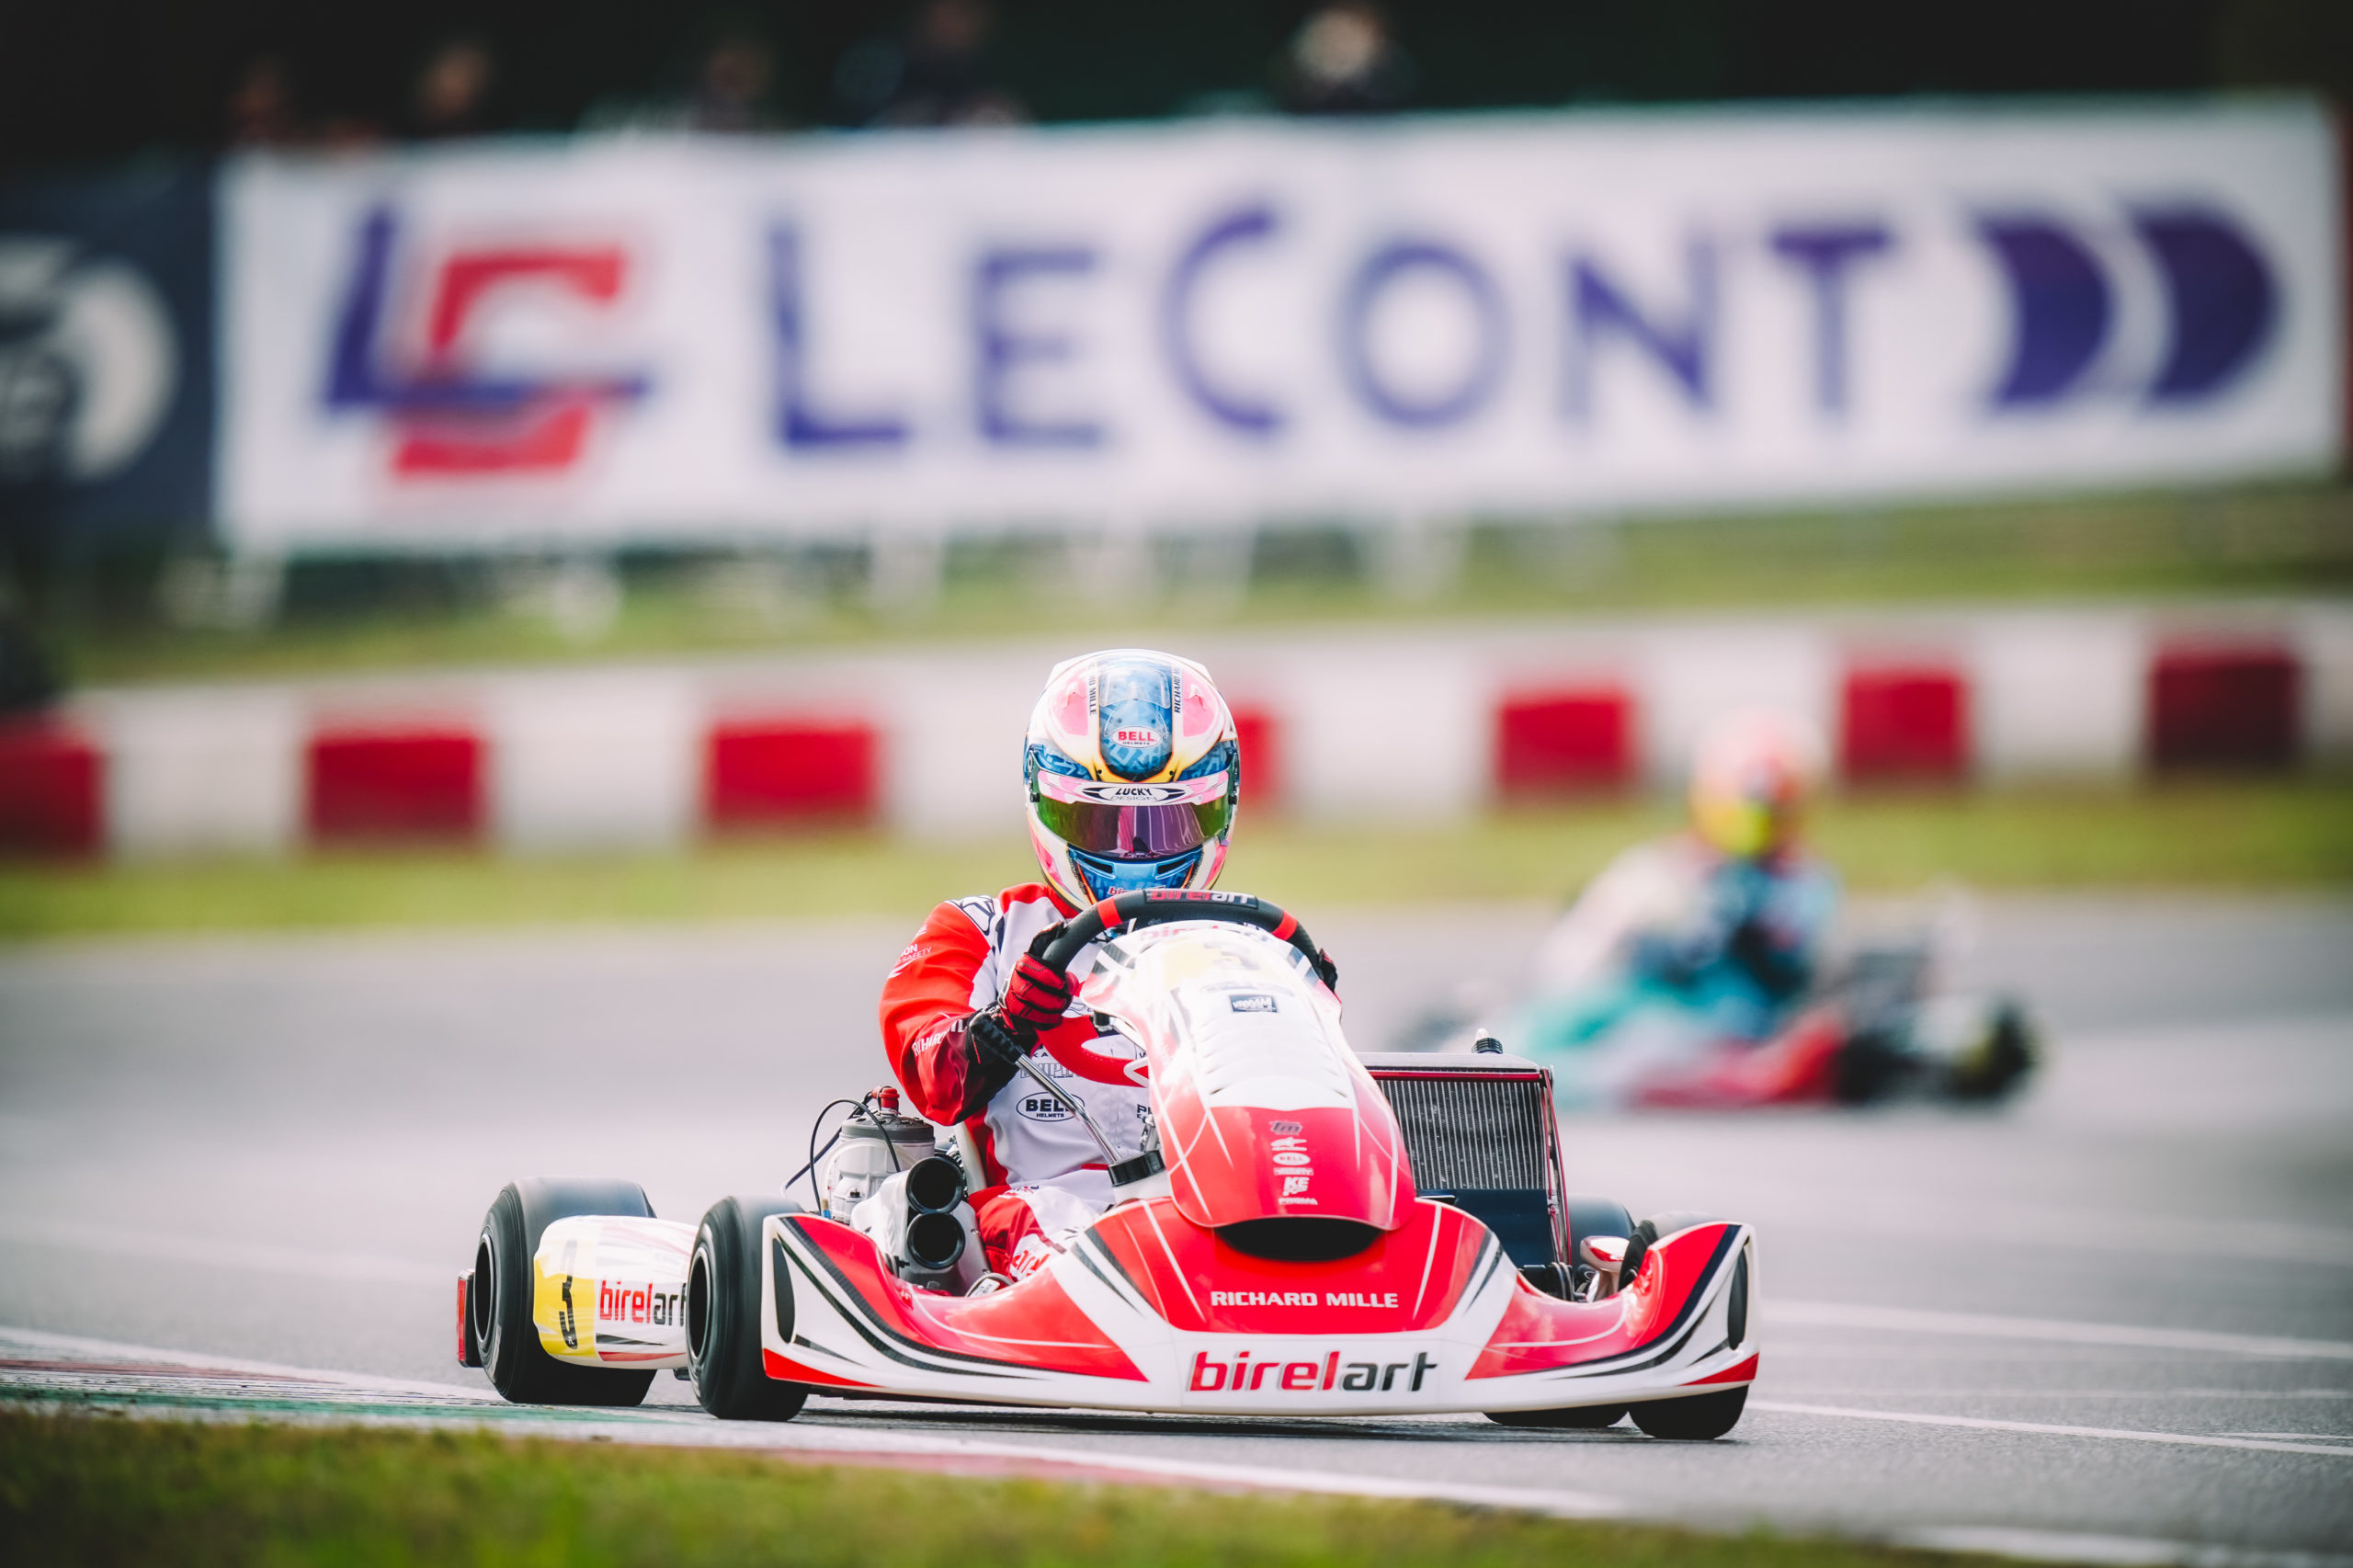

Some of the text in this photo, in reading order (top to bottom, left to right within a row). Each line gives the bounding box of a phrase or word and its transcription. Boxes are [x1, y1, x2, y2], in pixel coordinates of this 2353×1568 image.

[1118, 731, 1155, 742] BELL
[1115, 788, 1153, 796] LUCKY
[1211, 1290, 1399, 1309] RICHARD MILLE
[1187, 1350, 1438, 1392] birelart
